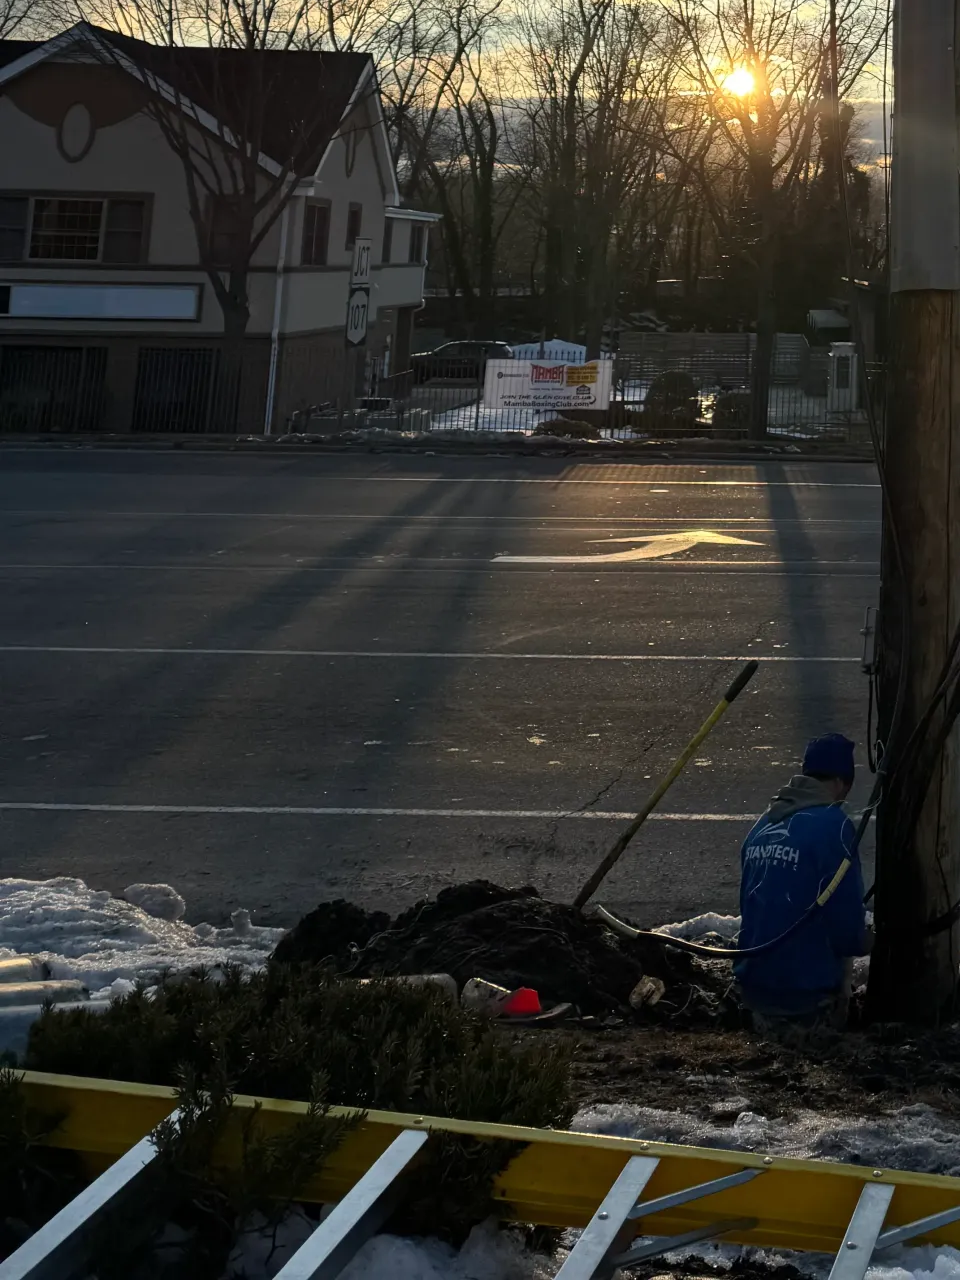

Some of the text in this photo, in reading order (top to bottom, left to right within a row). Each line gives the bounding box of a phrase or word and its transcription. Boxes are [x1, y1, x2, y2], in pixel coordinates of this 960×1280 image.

[354, 246, 370, 277] JCT
[350, 304, 366, 330] 107
[531, 364, 565, 380] MAMBA
[503, 400, 590, 408] MambaBoxingClub.com
